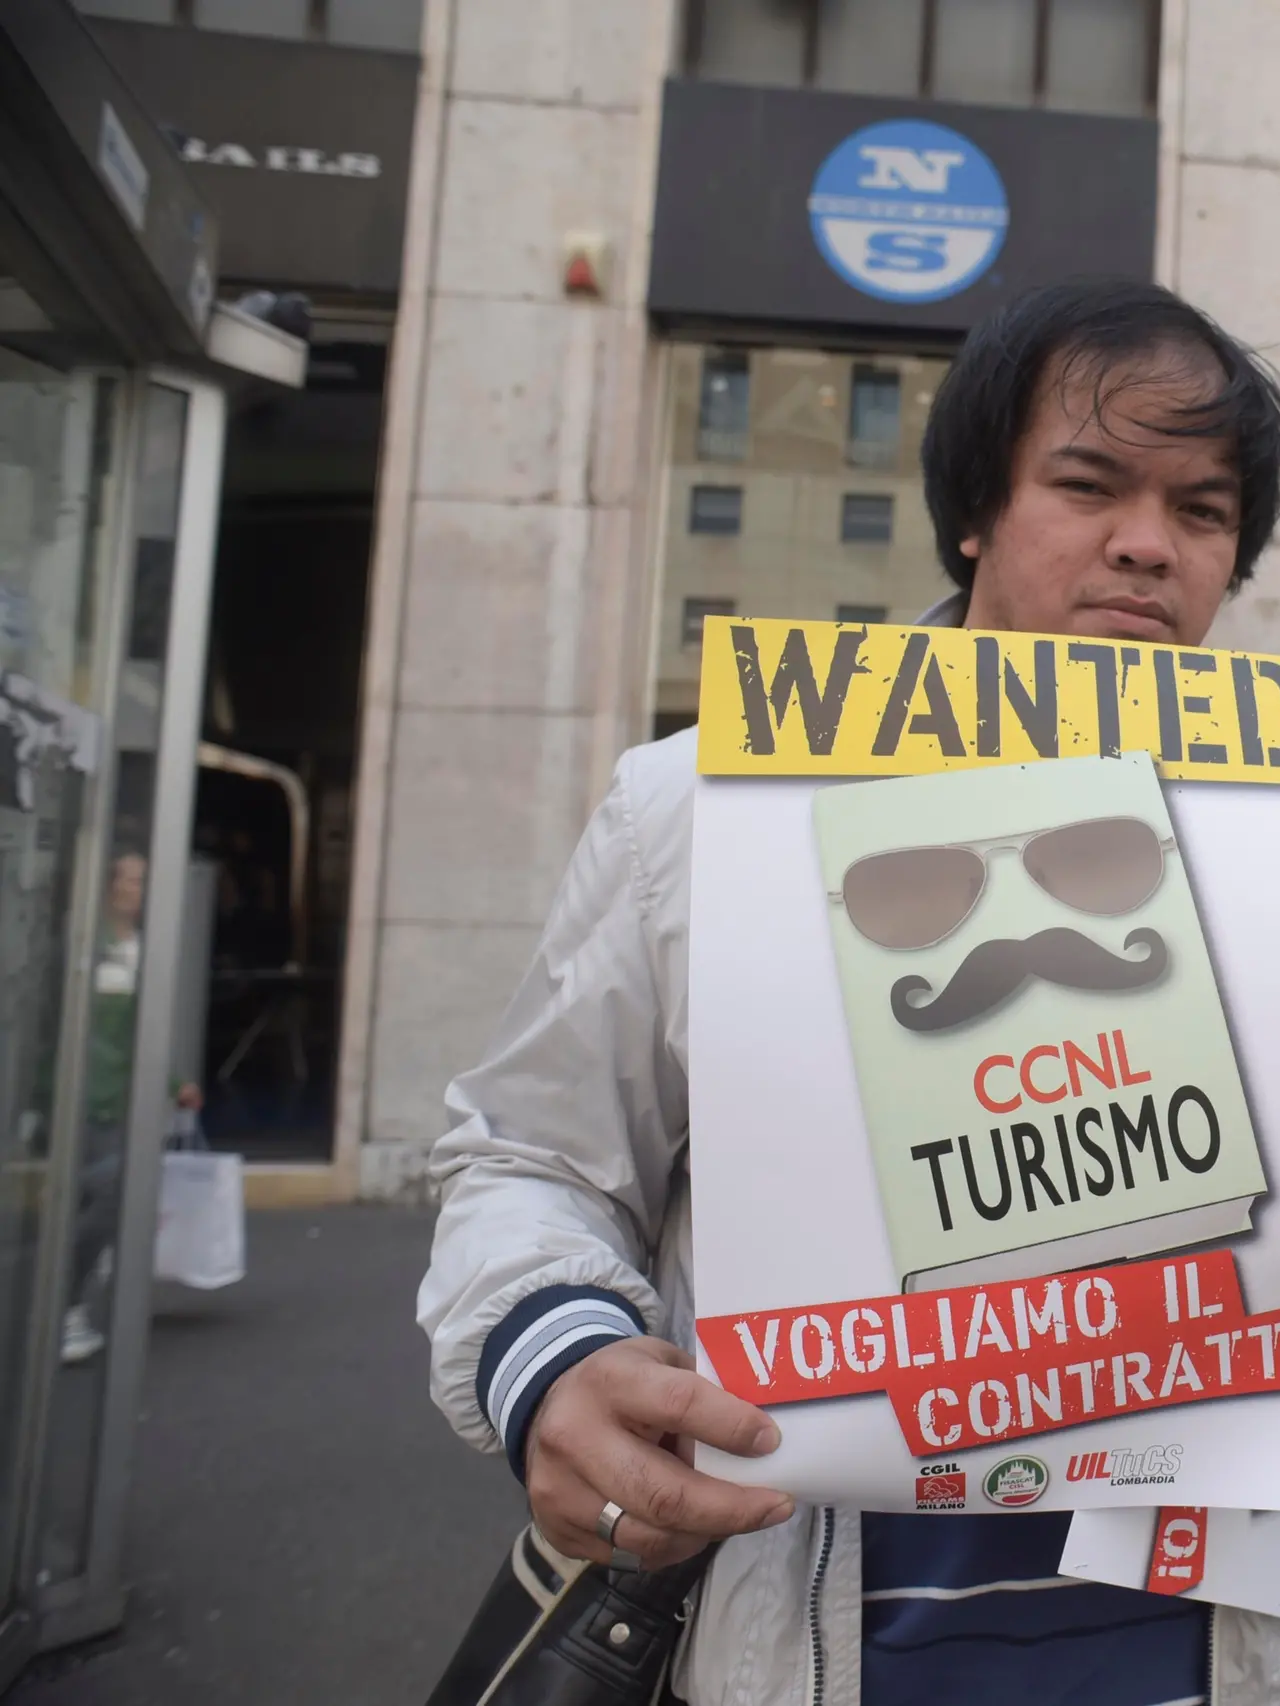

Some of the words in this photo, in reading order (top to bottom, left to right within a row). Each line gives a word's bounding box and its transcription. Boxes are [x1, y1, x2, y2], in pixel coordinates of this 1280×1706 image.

[858, 145, 966, 194] N
[865, 232, 947, 273] S
[972, 1029, 1153, 1114] CCNL
[911, 1084, 1222, 1232] TURISMO
[733, 1275, 1118, 1386] VOGLIAMO
[1163, 1262, 1224, 1324] IL
[920, 1463, 961, 1476] CGIL
[1110, 1476, 1176, 1486] LOMBARDIA
[916, 1502, 966, 1510] MILANO
